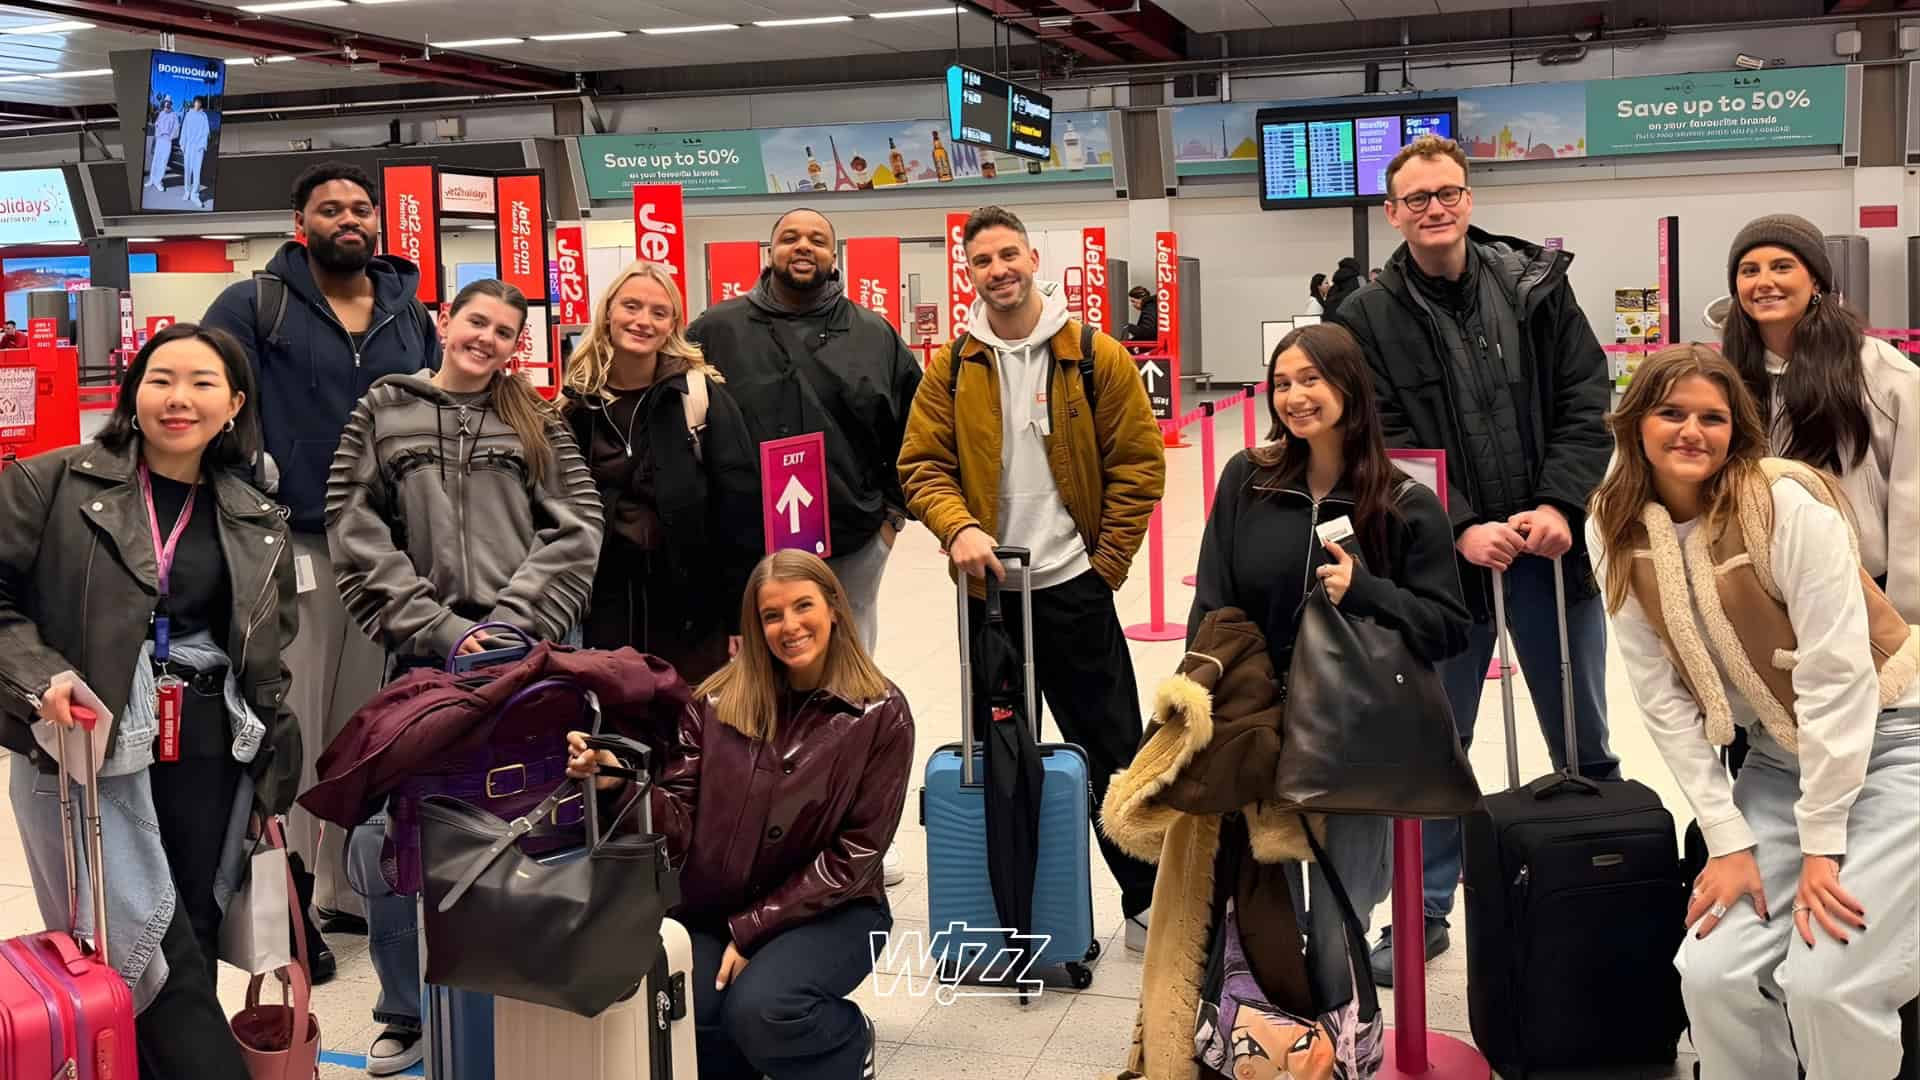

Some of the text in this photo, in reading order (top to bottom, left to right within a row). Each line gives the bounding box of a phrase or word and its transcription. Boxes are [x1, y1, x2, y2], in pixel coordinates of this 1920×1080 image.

[1617, 89, 1811, 118] Save up to 50%
[1649, 122, 1662, 131] on
[1664, 121, 1687, 132] your
[604, 148, 740, 169] Save up to 50%
[518, 201, 531, 275] Jet2.com
[1158, 239, 1172, 332] Jet2.com
[783, 450, 806, 467] EXIT
